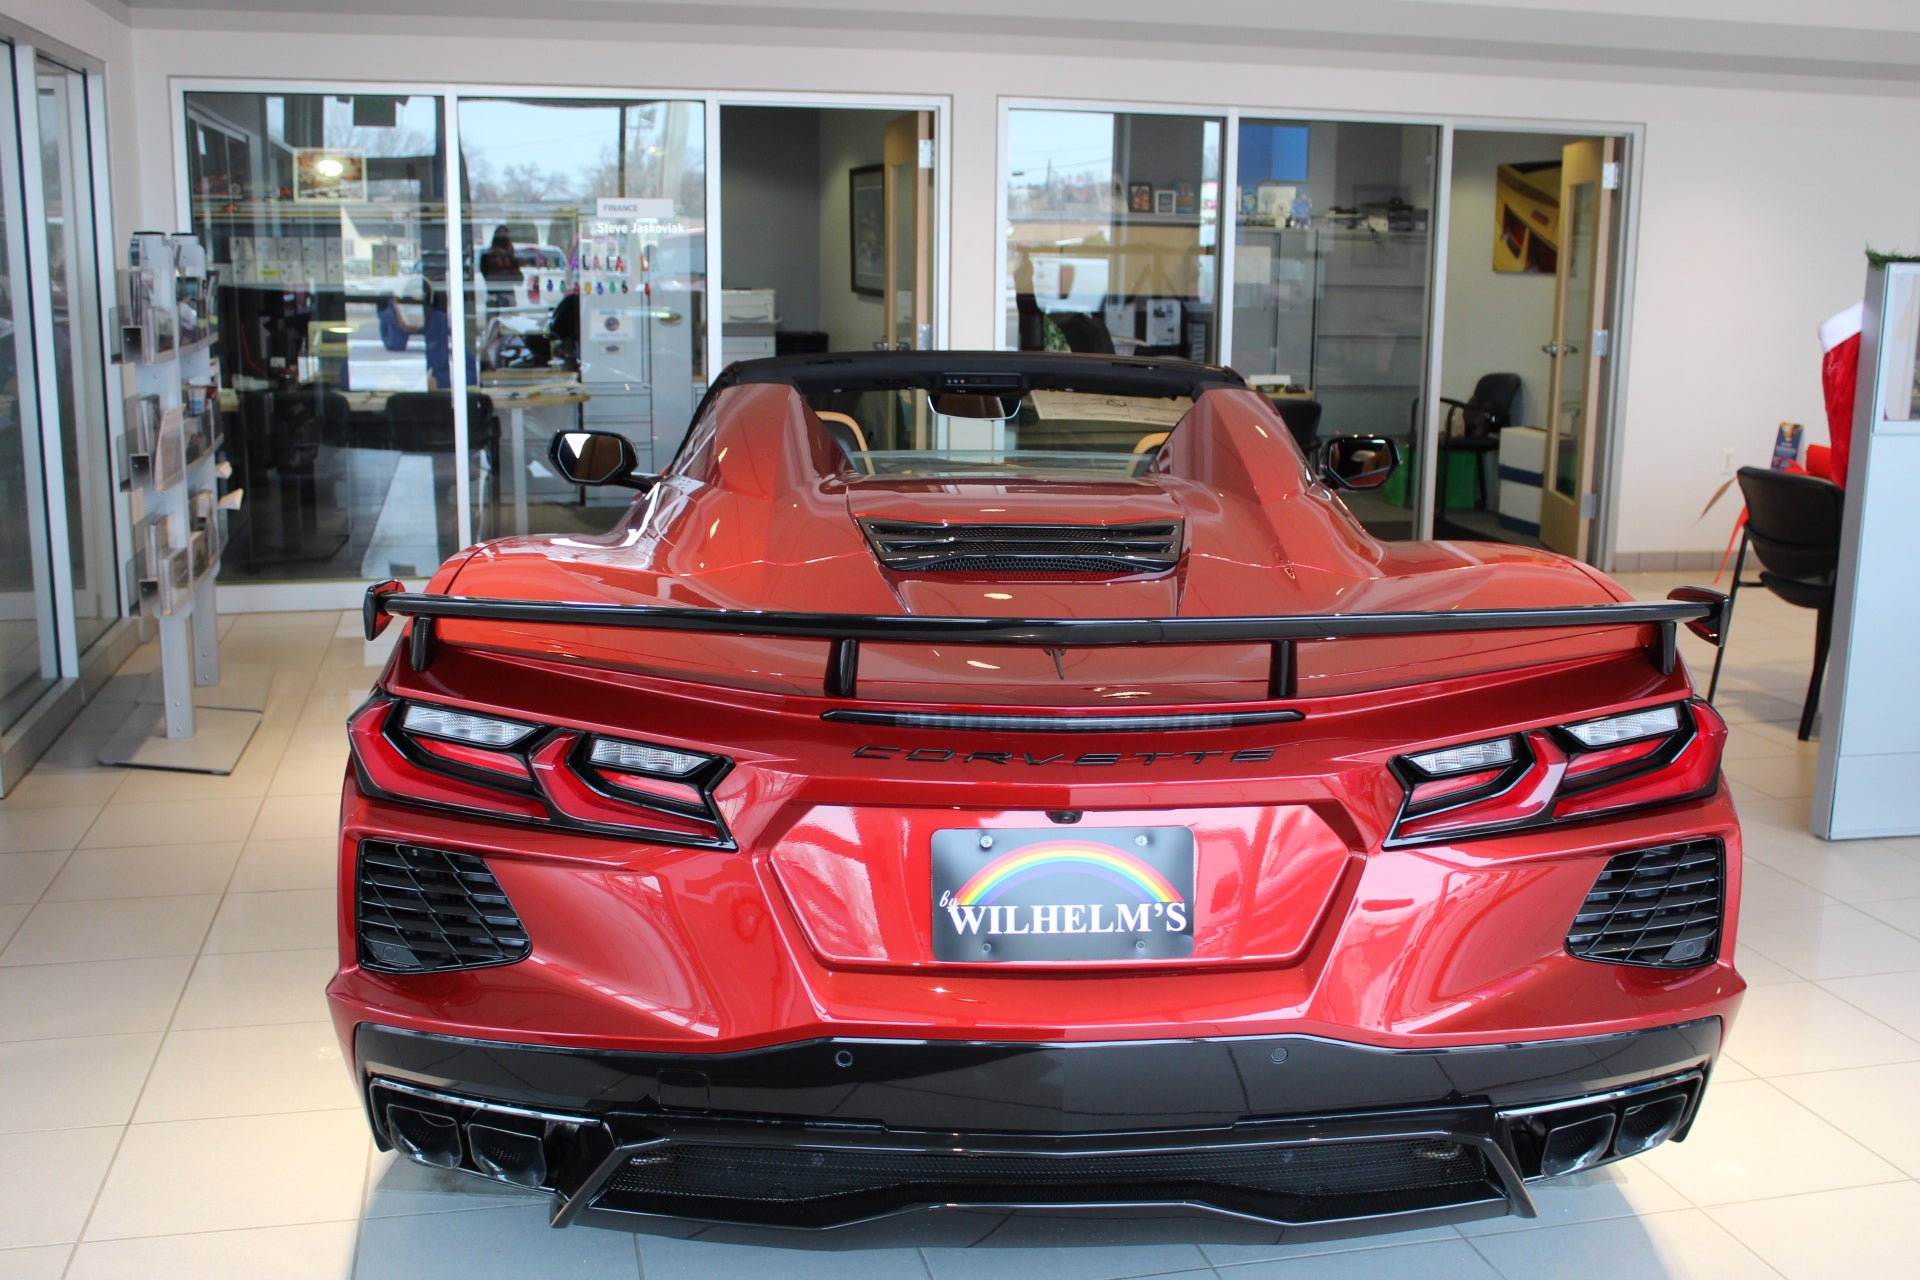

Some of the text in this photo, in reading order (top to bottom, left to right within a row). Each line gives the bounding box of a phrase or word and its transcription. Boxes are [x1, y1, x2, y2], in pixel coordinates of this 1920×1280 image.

[603, 204, 638, 212] FINANCE
[597, 221, 628, 233] Steve
[851, 745, 1276, 766] CORVETTE
[939, 890, 960, 912] by
[947, 902, 1187, 935] WILHELM'S
